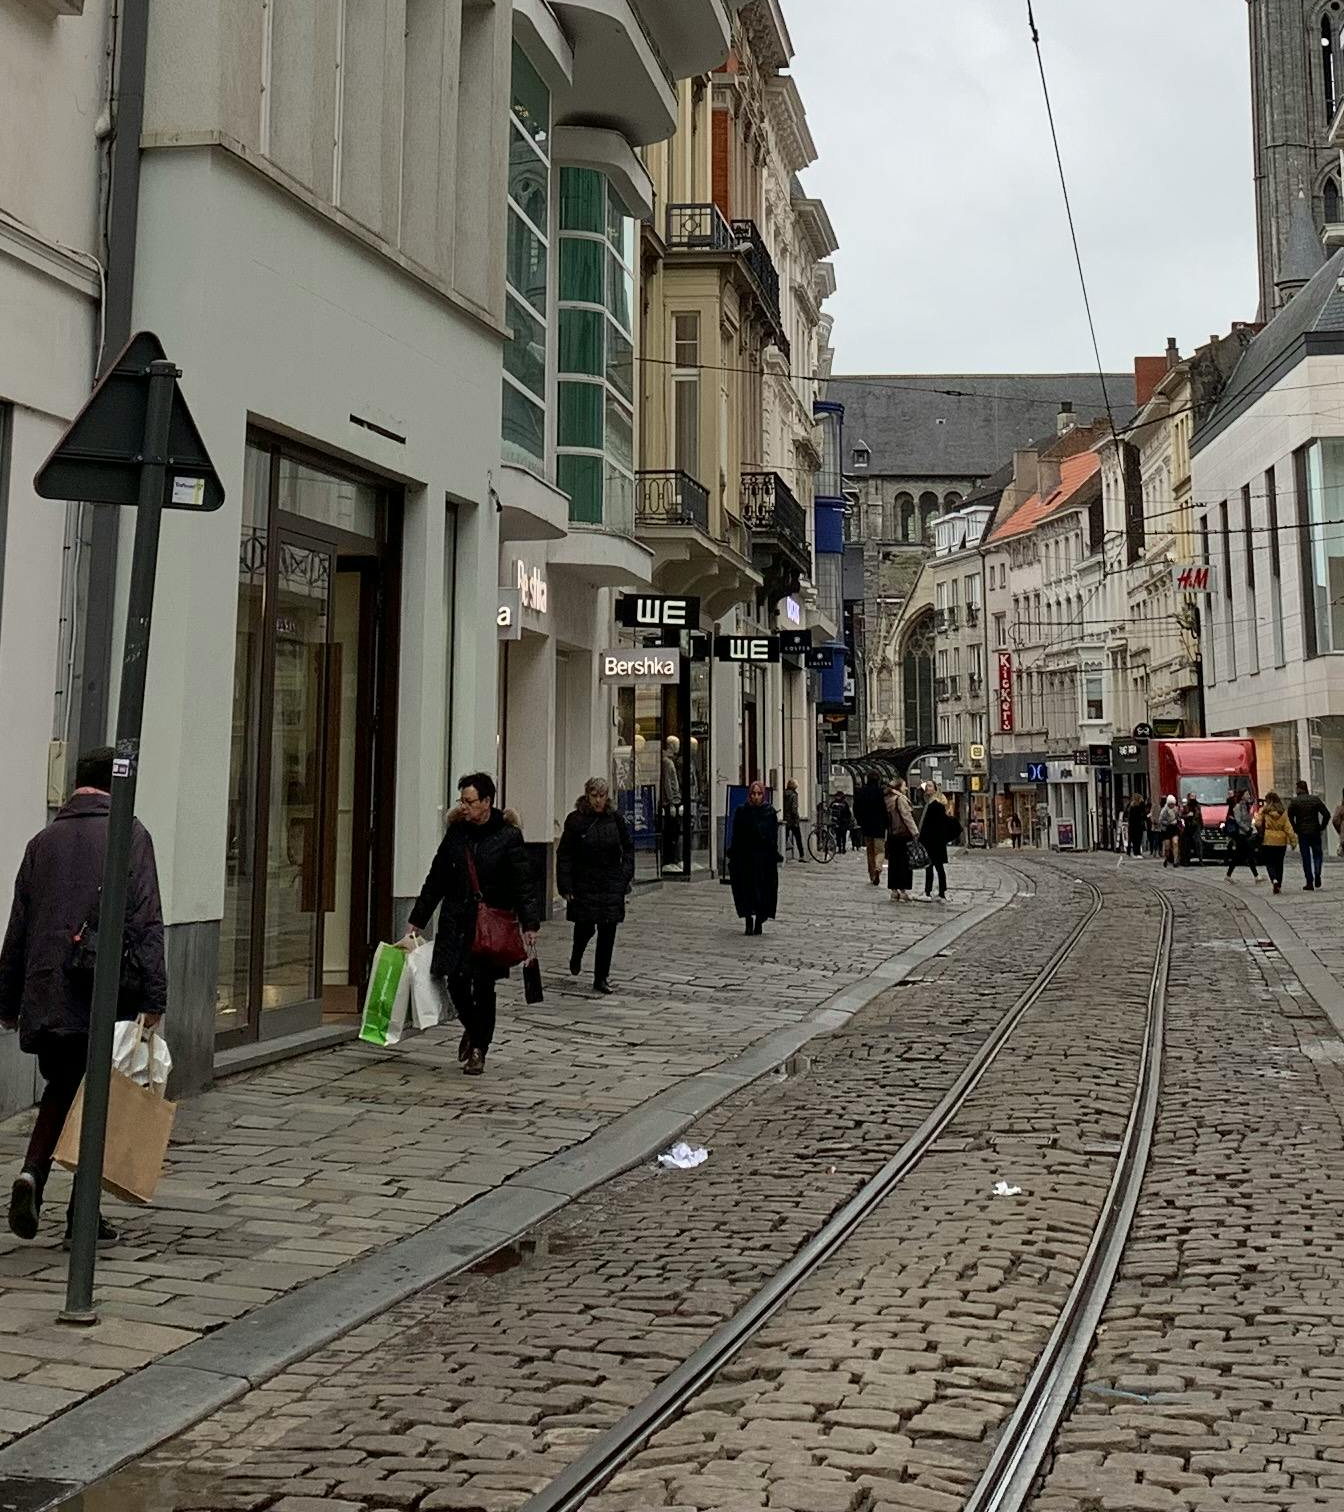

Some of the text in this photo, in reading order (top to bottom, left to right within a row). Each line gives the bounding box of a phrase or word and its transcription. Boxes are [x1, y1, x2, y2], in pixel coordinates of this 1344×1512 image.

[1176, 567, 1209, 589] H&M
[636, 598, 687, 625] WE
[729, 639, 769, 660] WE
[605, 657, 675, 676] Bershka
